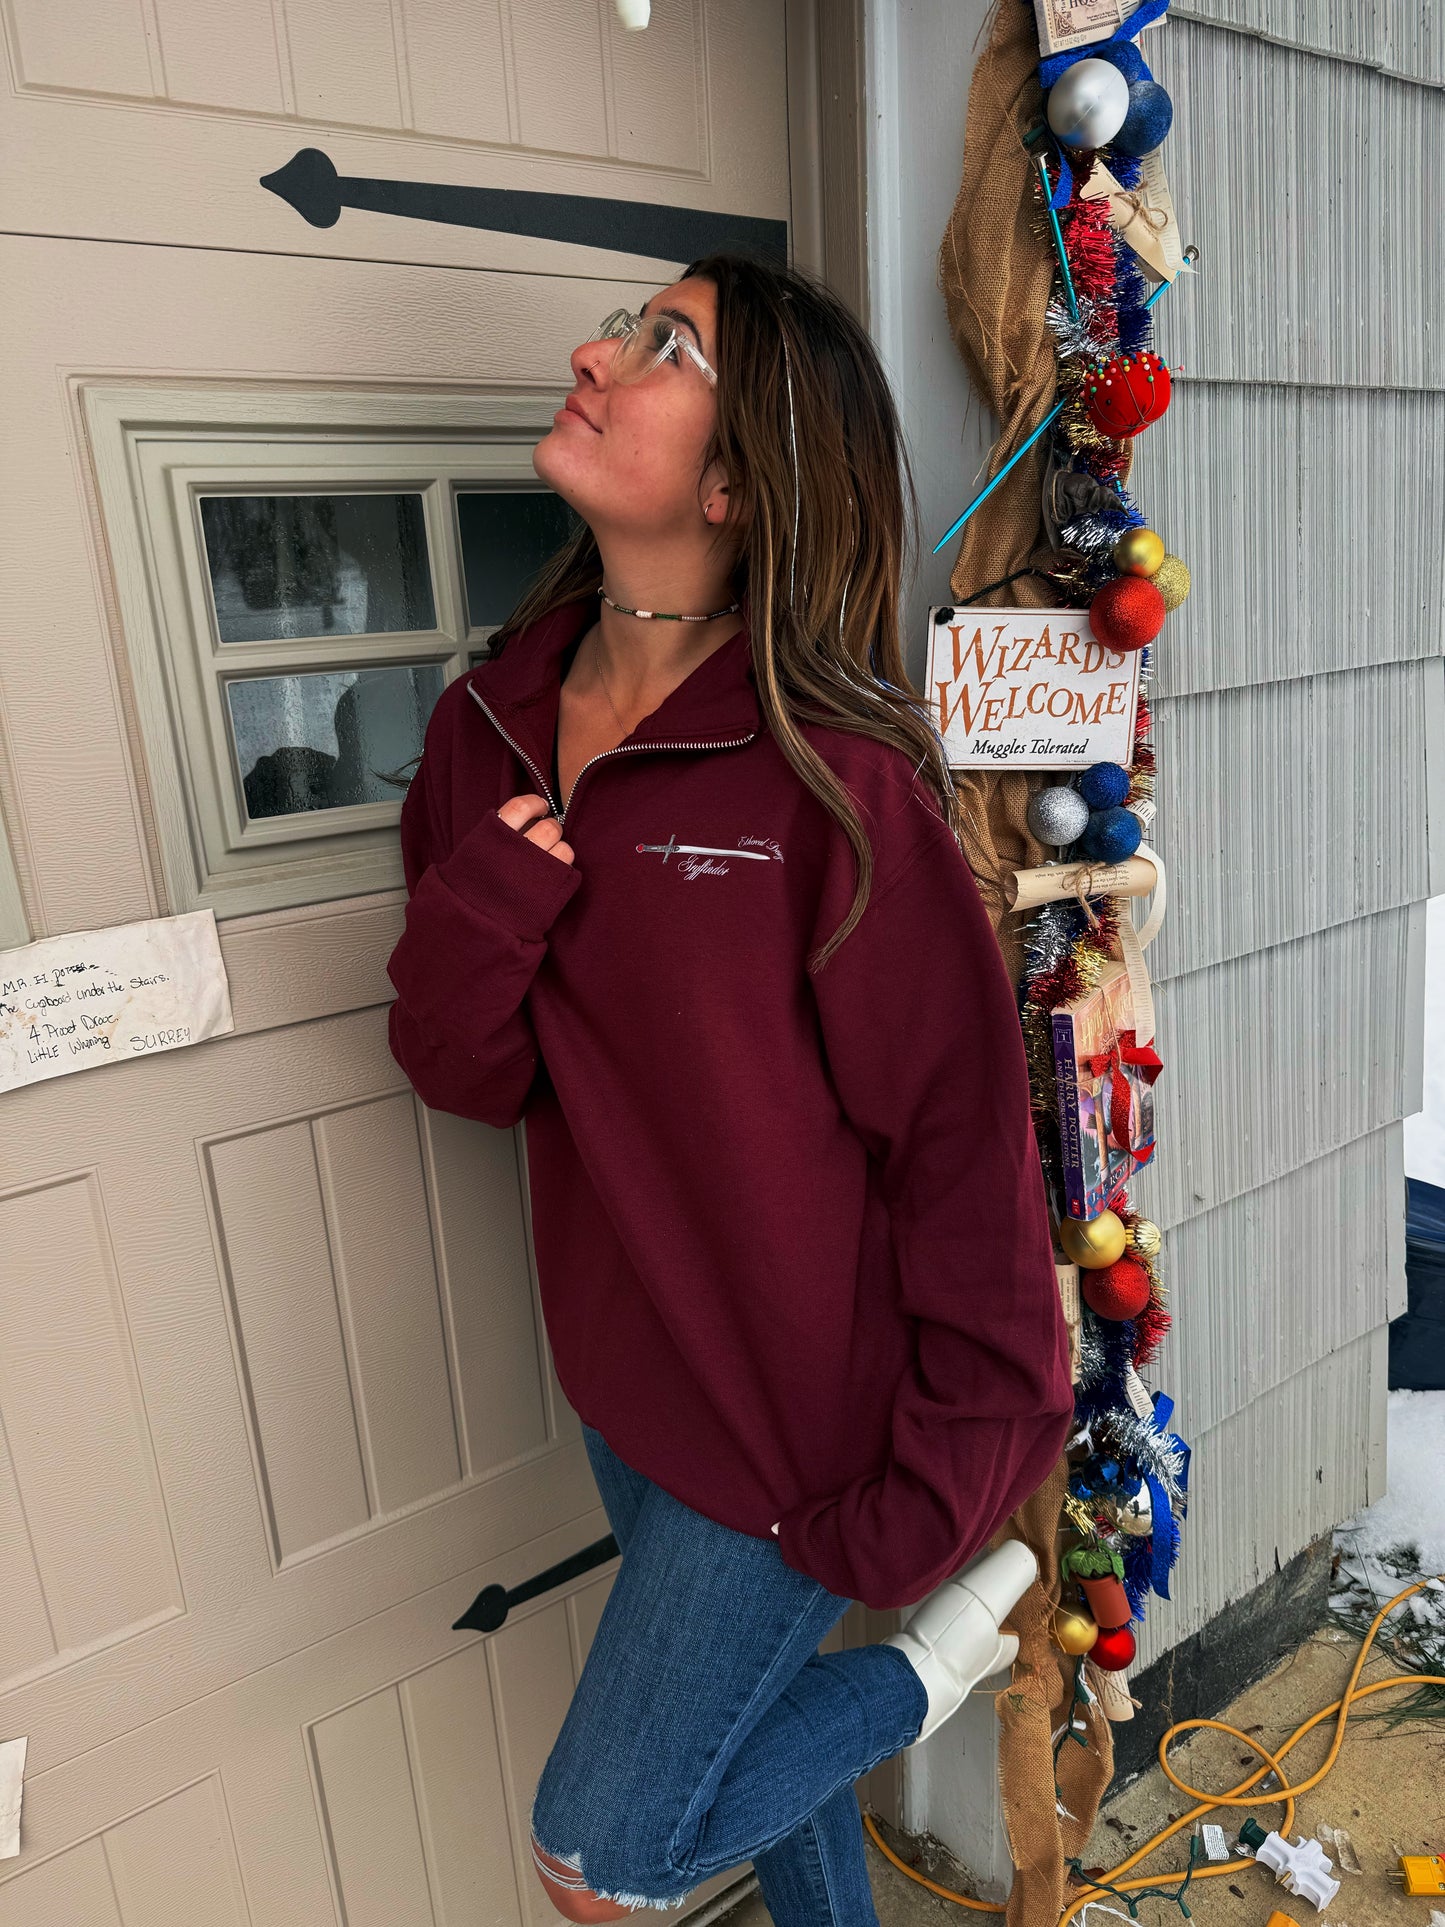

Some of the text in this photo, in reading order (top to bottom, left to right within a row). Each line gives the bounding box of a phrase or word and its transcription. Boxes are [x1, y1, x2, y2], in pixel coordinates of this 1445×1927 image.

[947, 622, 1126, 683] WIZARDS
[934, 678, 1130, 738] WELCOME
[970, 738, 1090, 759] Muggles Tolerated
[129, 1026, 191, 1052] SURREY
[1064, 1058, 1080, 1168] HARRY POTTER
